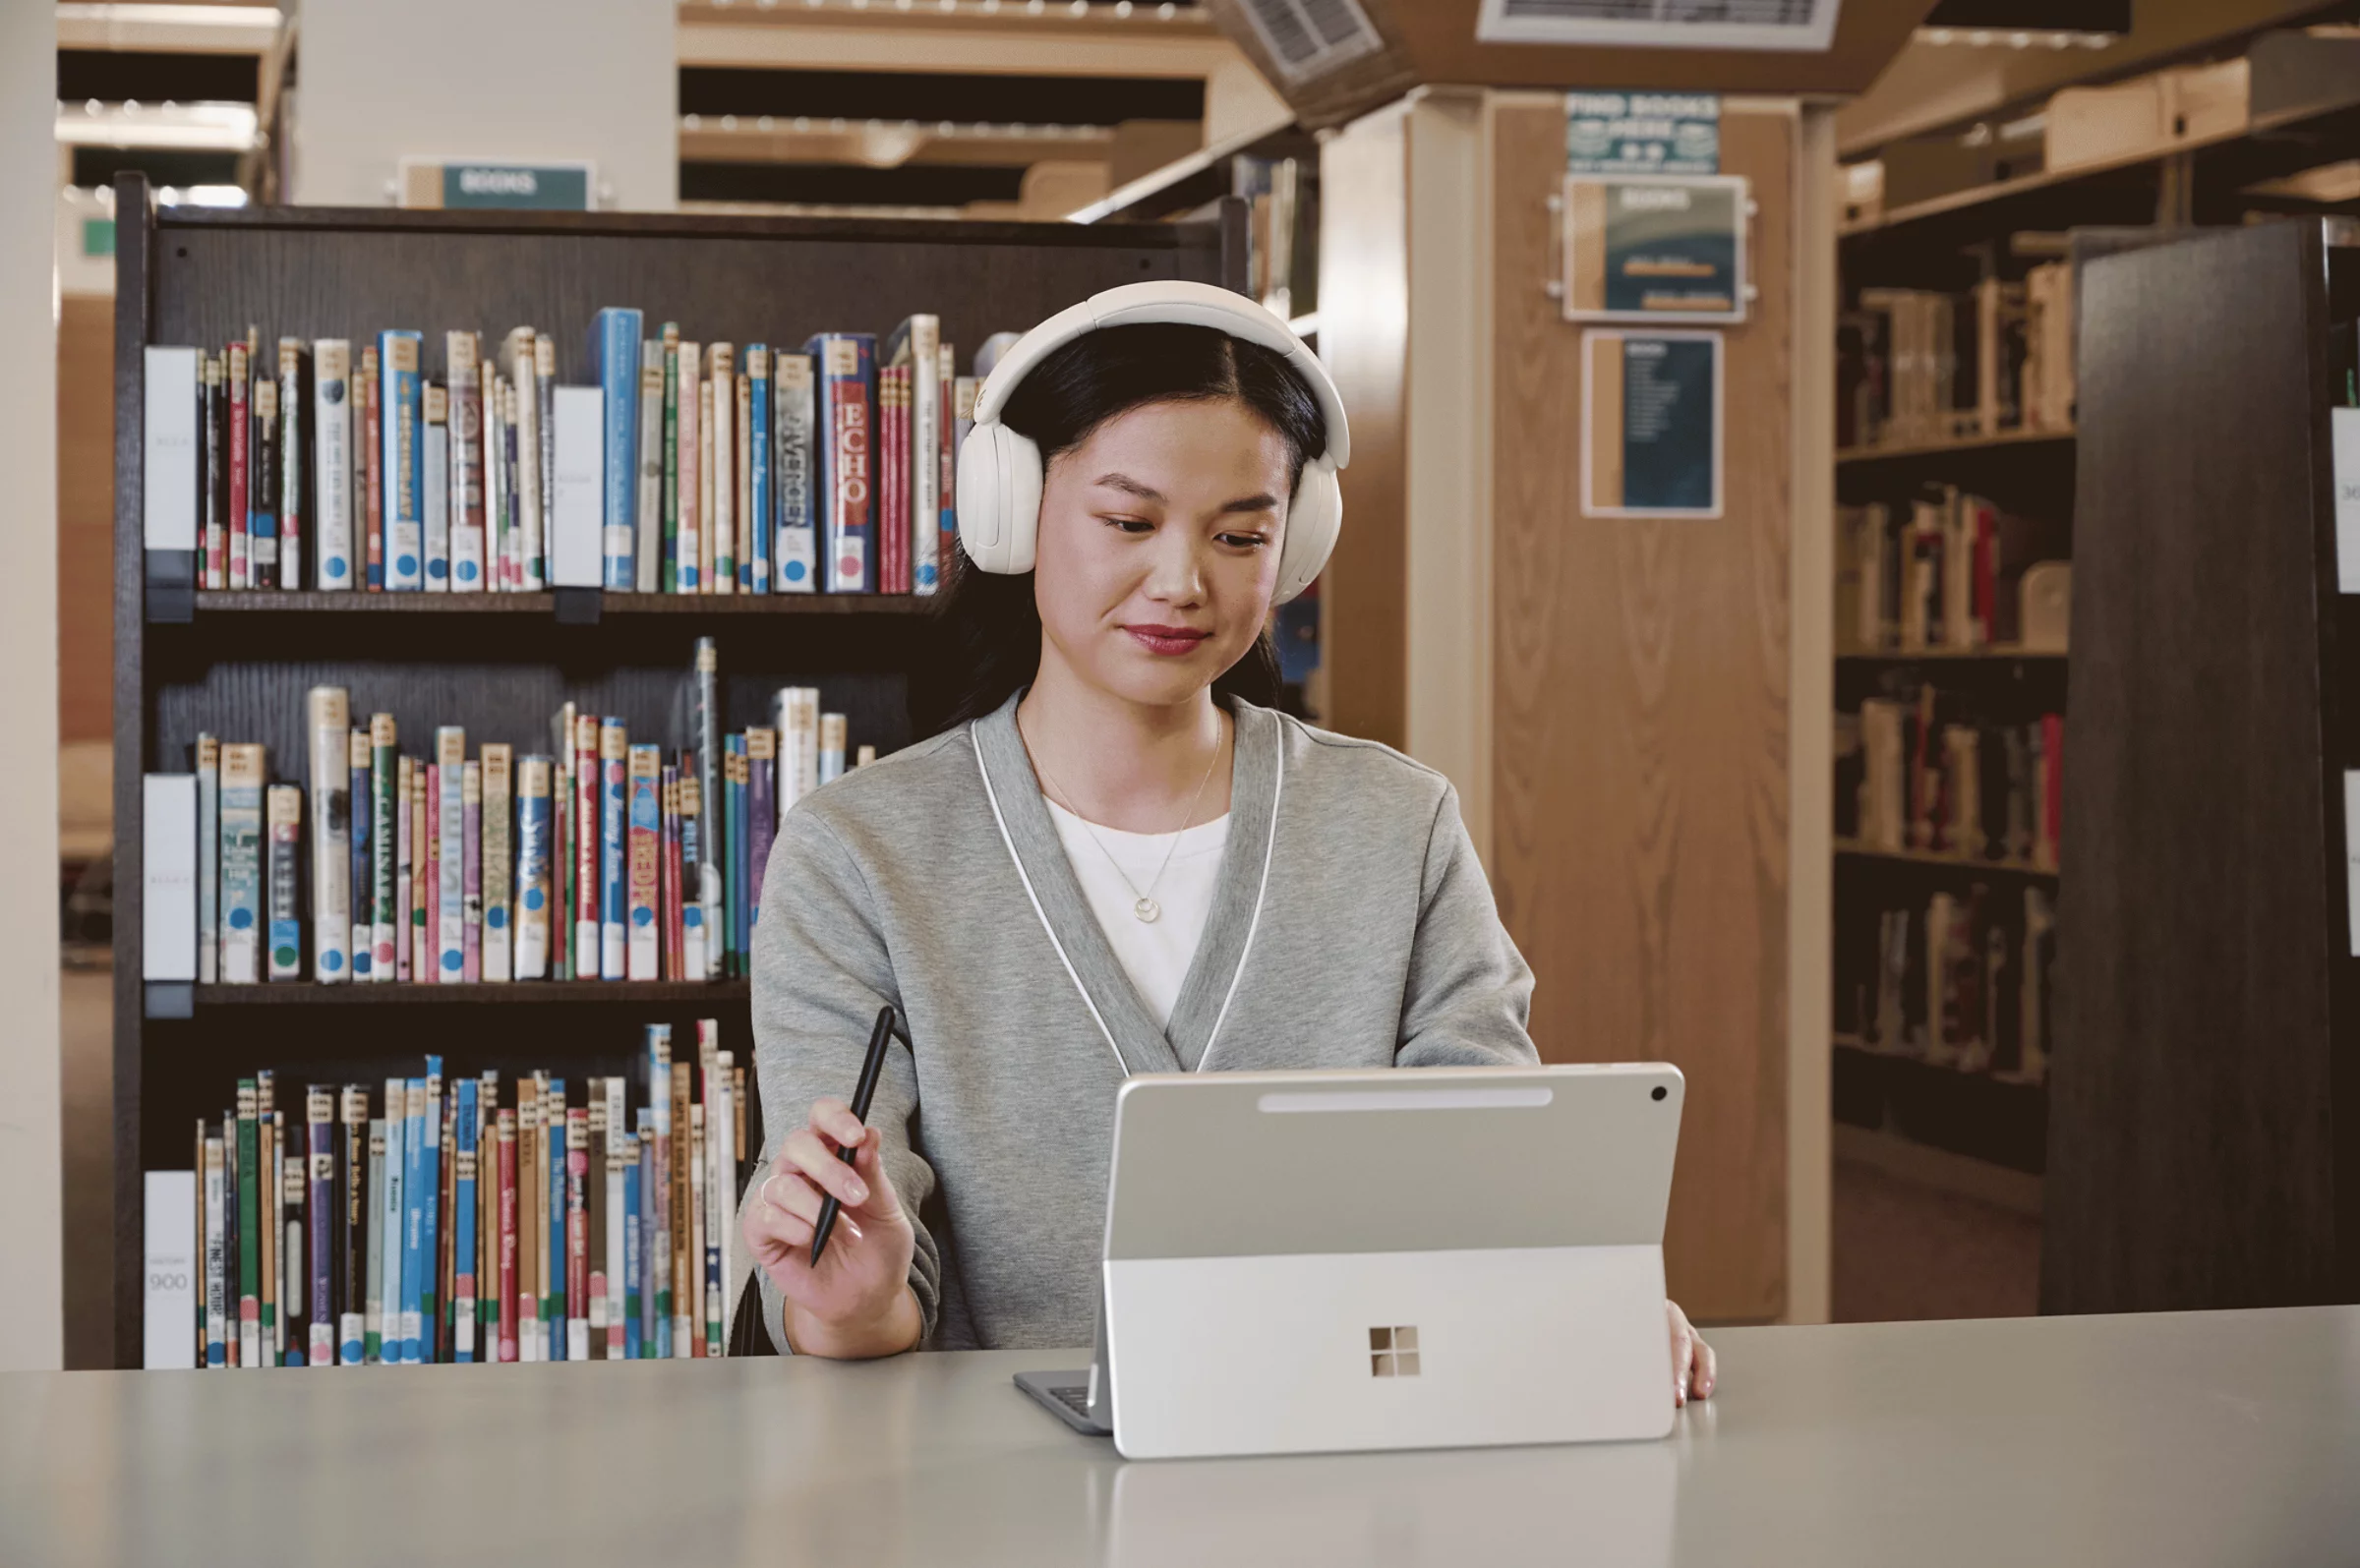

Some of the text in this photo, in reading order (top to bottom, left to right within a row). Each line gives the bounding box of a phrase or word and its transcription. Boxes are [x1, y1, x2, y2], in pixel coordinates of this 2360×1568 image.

[1629, 94, 1718, 117] BOOKS
[841, 403, 867, 503] ECHO
[378, 796, 393, 899] CAMINAR
[149, 1272, 188, 1292] 900
